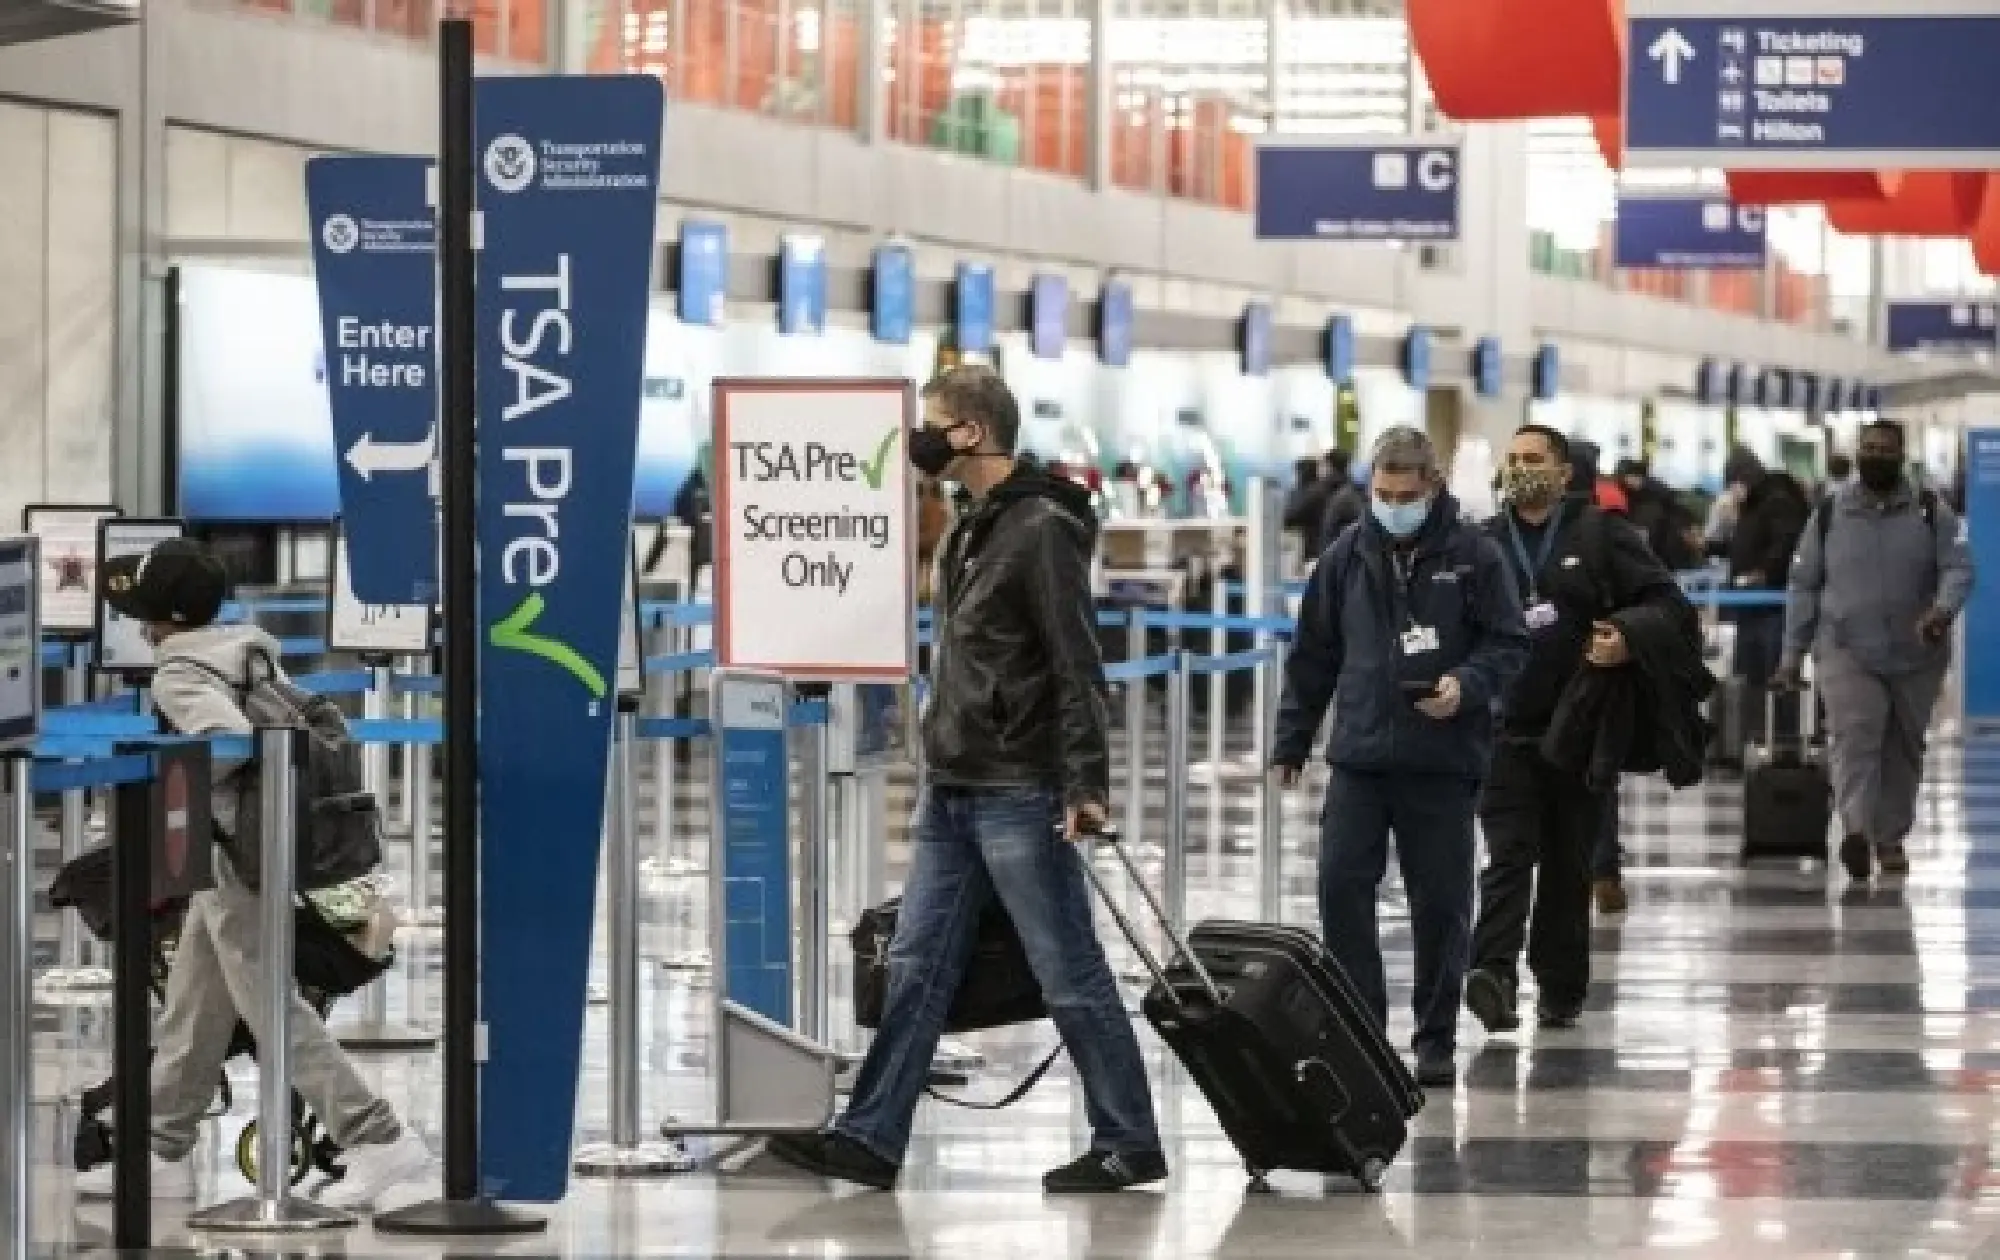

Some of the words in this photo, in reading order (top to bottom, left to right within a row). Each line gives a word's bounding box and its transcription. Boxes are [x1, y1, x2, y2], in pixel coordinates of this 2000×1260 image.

[1756, 29, 1863, 56] Ticketing
[1753, 91, 1832, 112] Toilets
[1752, 118, 1825, 140] Hilton
[1417, 150, 1453, 191] C
[337, 316, 432, 347] Enter
[501, 253, 573, 421] TSA
[340, 354, 425, 387] Here
[730, 442, 801, 481] TSA
[806, 442, 857, 481] Pre
[502, 448, 573, 585] Pre
[743, 504, 888, 548] Screening
[781, 551, 853, 596] Only
